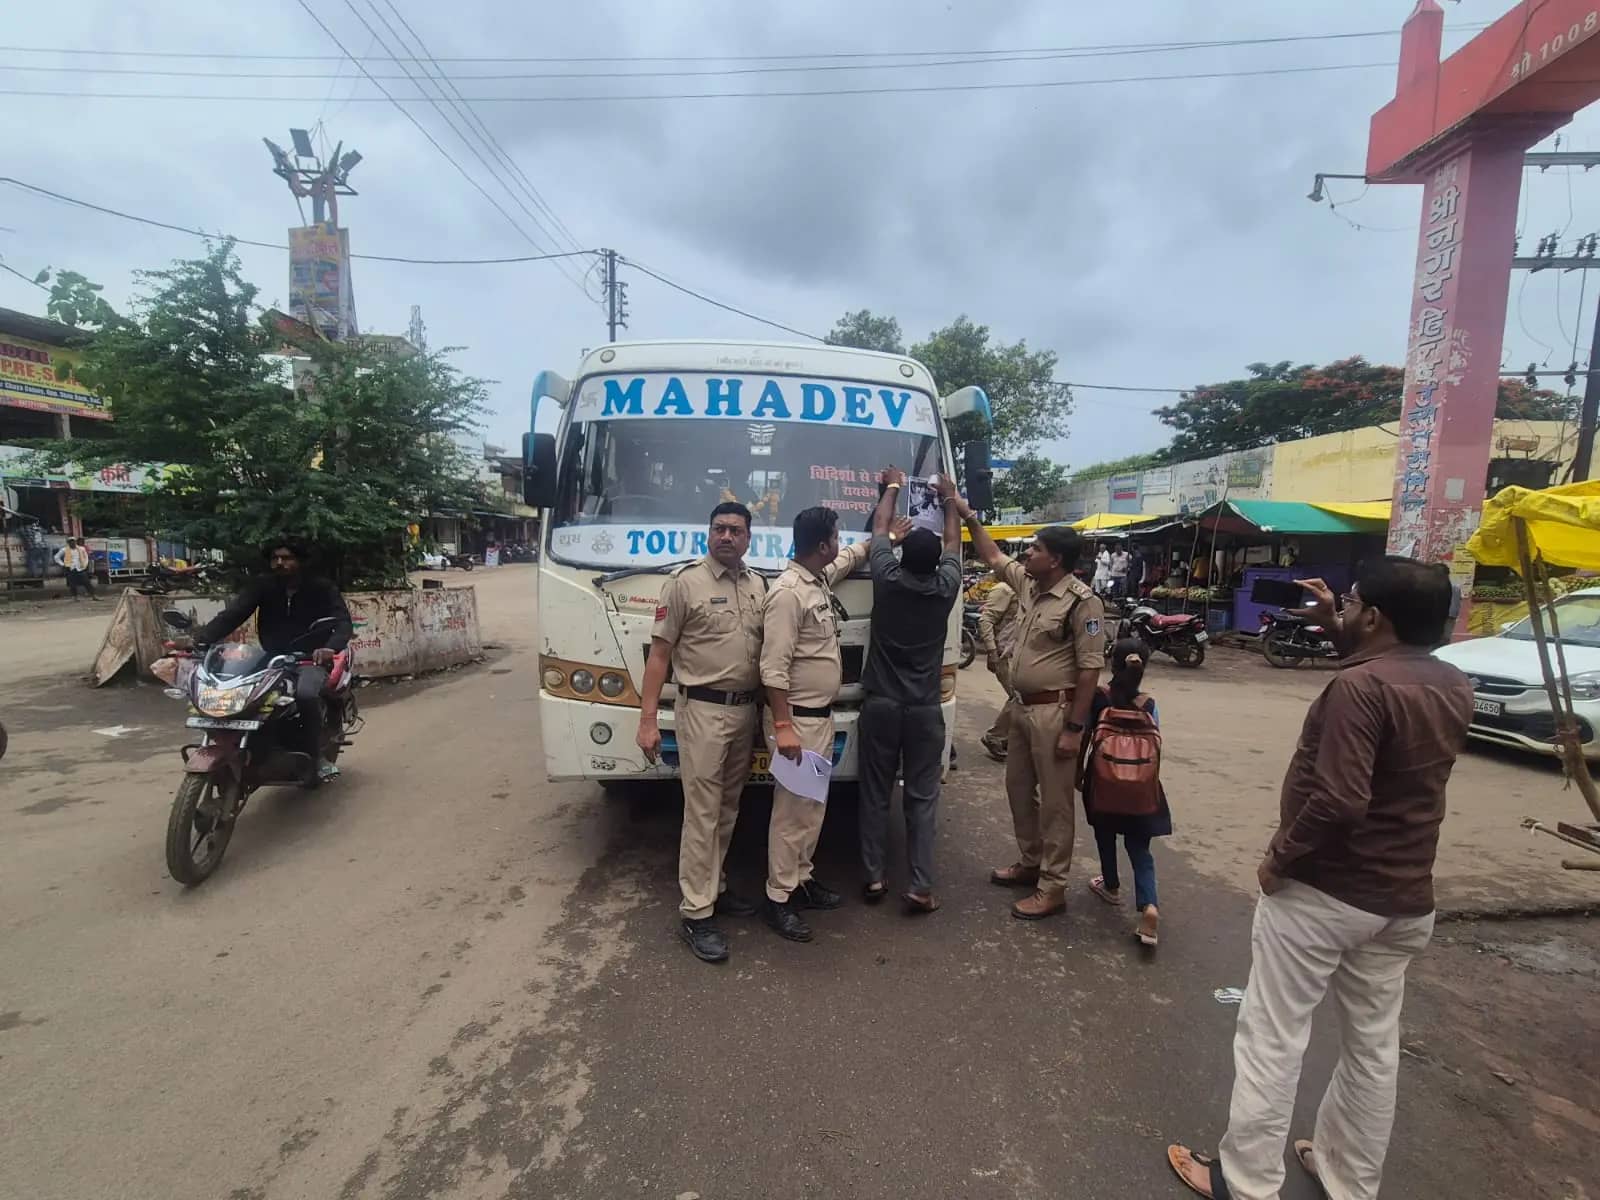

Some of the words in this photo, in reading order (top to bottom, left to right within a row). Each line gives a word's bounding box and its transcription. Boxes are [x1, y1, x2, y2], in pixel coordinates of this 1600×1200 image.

[1540, 11, 1597, 61] 1008
[1430, 184, 1461, 224] श्री
[601, 377, 912, 428] MAHADEV
